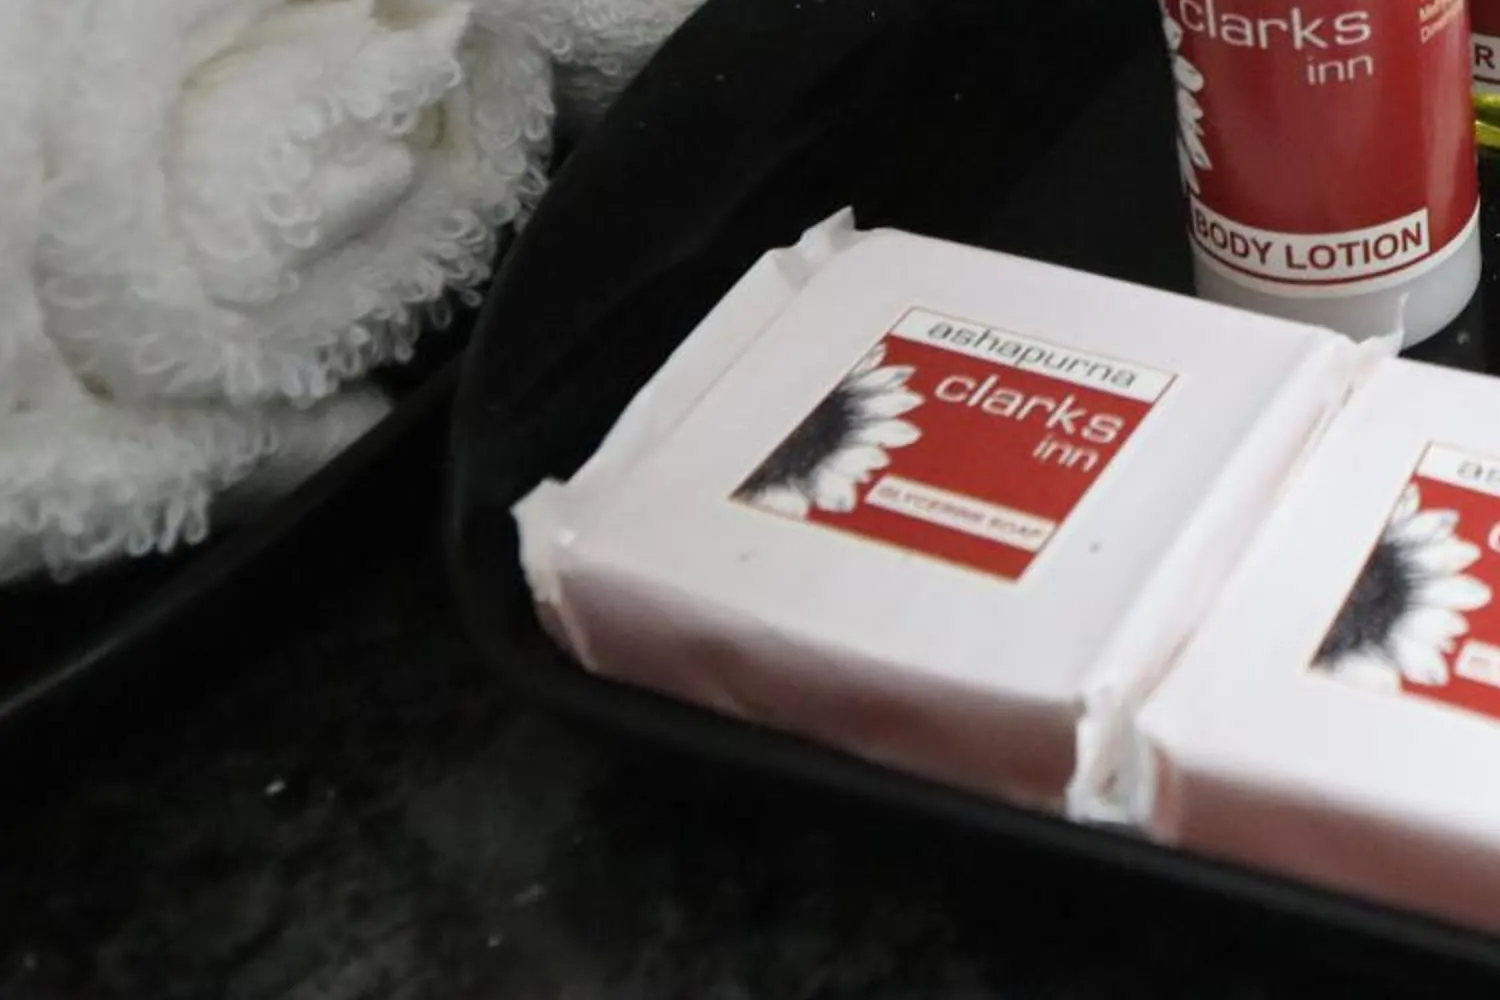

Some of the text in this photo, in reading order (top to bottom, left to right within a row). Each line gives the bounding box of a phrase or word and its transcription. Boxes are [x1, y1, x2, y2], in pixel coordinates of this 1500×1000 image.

[1307, 53, 1374, 86] inn
[1195, 207, 1423, 272] BODY LOTION
[928, 320, 1137, 389] ashapurna
[935, 374, 1125, 445] clarks
[1033, 432, 1099, 474] inn
